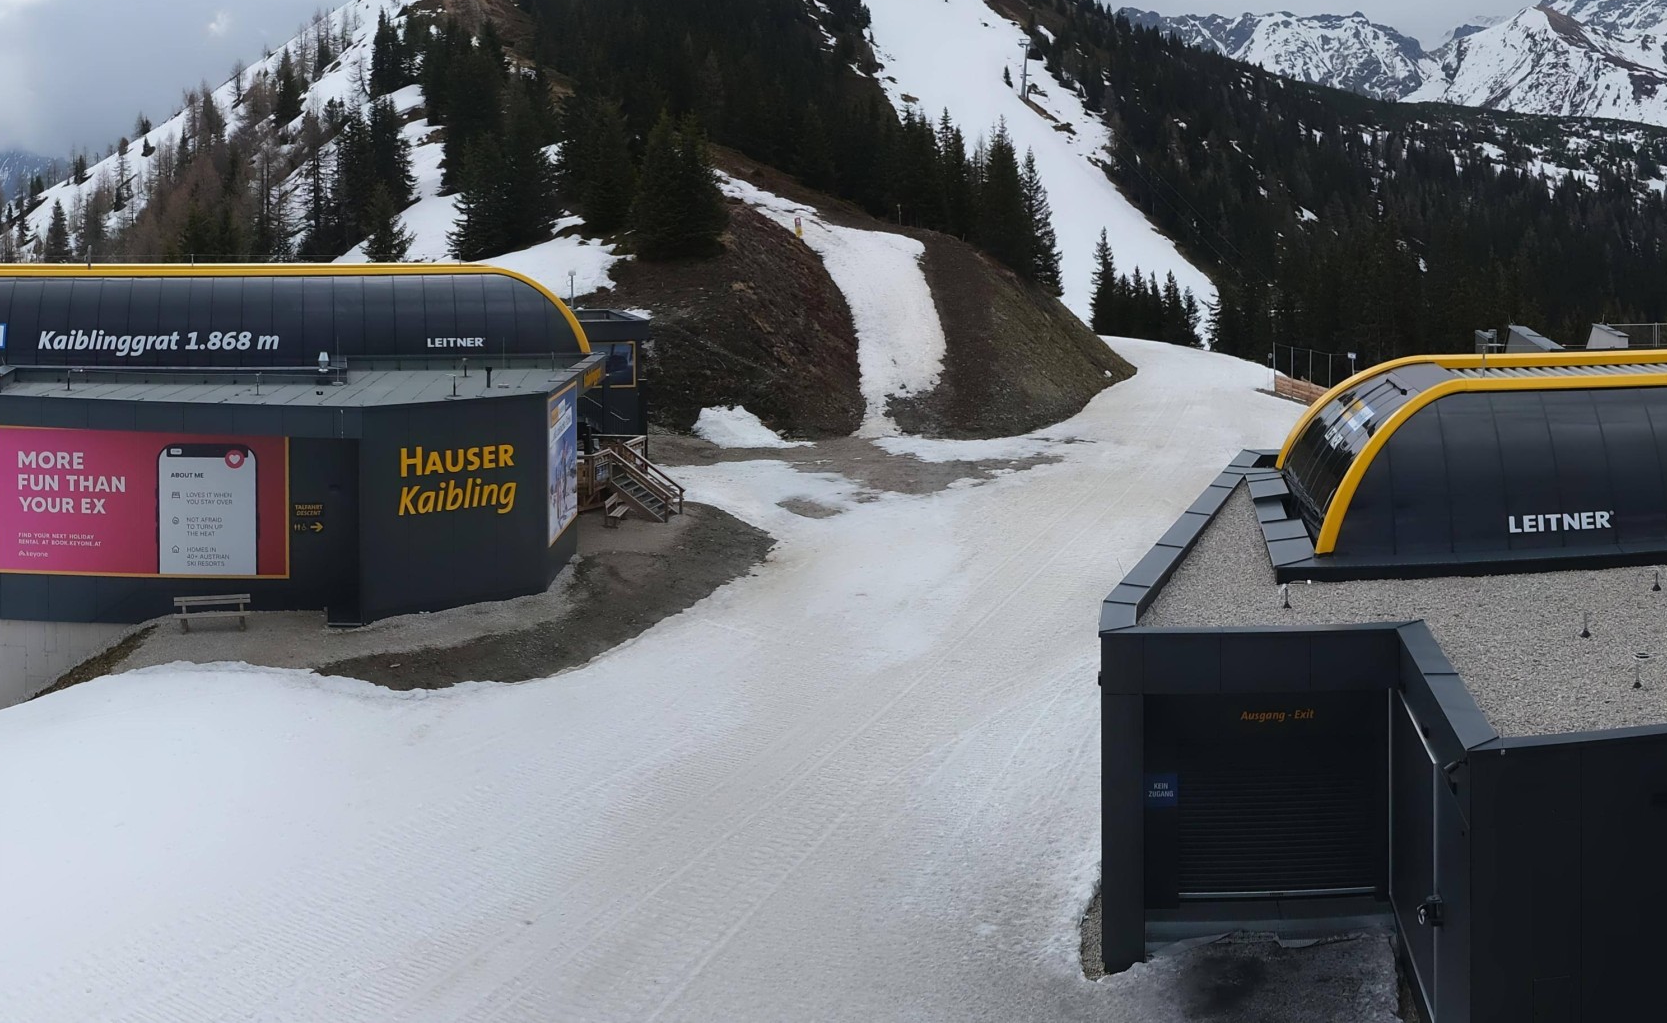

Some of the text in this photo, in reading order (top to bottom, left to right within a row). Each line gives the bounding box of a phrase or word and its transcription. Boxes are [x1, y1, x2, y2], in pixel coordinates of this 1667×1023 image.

[38, 330, 280, 357] Kaiblinggrat 1.868 m
[427, 338, 484, 348] LEITNER
[17, 450, 85, 470] MORE
[400, 444, 515, 478] HAUSER
[17, 473, 126, 493] FUN THAN
[19, 496, 106, 515] YOUR EX
[398, 477, 517, 516] Kaibling
[1508, 511, 1611, 534] LEITNER
[1240, 710, 1286, 723] Ausgang
[1294, 708, 1315, 720] Exit
[1148, 790, 1174, 798] ZUGANG
[1153, 782, 1169, 790] KEIN
